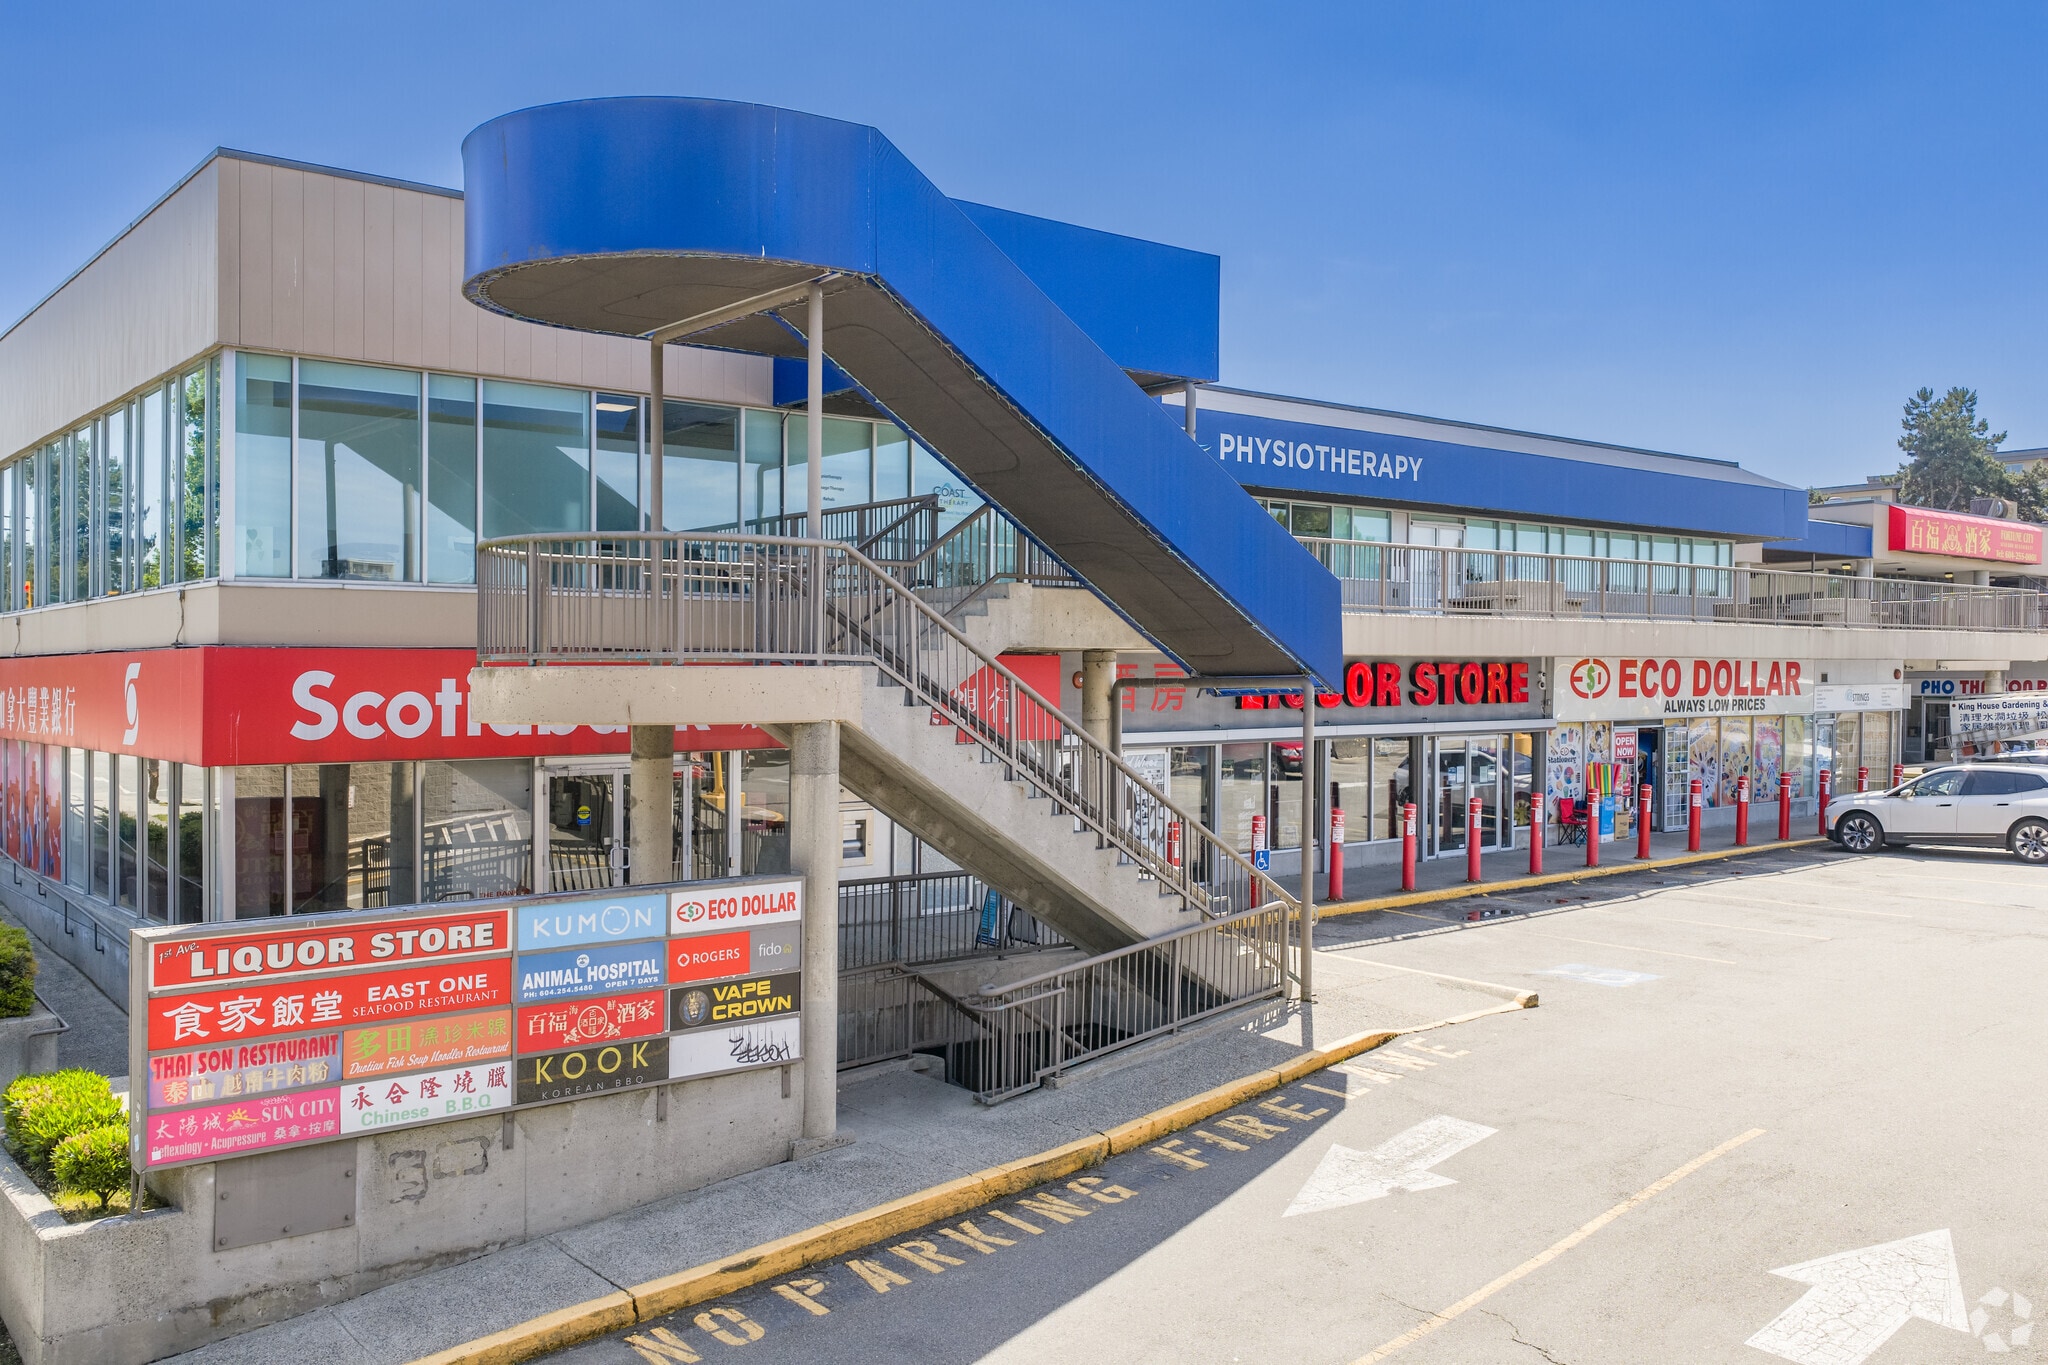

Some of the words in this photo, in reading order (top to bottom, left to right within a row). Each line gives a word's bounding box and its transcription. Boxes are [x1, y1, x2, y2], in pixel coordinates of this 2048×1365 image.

[1219, 432, 1423, 482] PHYSIOTHERAPY
[933, 485, 966, 498] COAST
[1409, 661, 1529, 708] STORE
[1618, 659, 1682, 698] ECO
[1692, 659, 1802, 697] DOLLAR
[1921, 680, 1955, 694] PHO
[1664, 699, 1706, 713] ALWAYS
[1708, 699, 1729, 713] LOW
[1731, 698, 1766, 712] PRICES
[1958, 702, 1975, 712] King
[1976, 702, 2000, 710] House
[2001, 700, 2040, 710] Gardening
[1615, 736, 1635, 746] OPEN
[1616, 747, 1634, 756] NOW
[708, 897, 738, 920] ECO
[741, 891, 797, 917] DOLLAR
[533, 905, 652, 938] KUMON
[158, 948, 173, 964] 1st
[175, 941, 200, 957] Ave.
[190, 937, 355, 978] LIQUOR
[370, 922, 494, 958] STORE
[692, 947, 740, 964] ROGERS
[758, 942, 782, 957] fido
[367, 980, 430, 1002] EAST
[439, 973, 488, 993] ONE
[522, 968, 583, 990] ANIMAL
[587, 958, 660, 983] HOSPITAL
[605, 980, 628, 989] OPEN
[638, 976, 659, 985] DAYS
[352, 1000, 414, 1017] SEAFOOD
[418, 989, 499, 1009] RESTAURANT
[539, 984, 593, 997] 604.254.5480
[712, 980, 771, 1002] VAPE
[162, 990, 343, 1041] 食家飯堂
[526, 1010, 568, 1036] 百福
[616, 999, 656, 1024] 酒家
[712, 994, 792, 1020] CROWN
[152, 1053, 194, 1080] THAI
[197, 1048, 234, 1076] SON
[237, 1034, 339, 1069] RESTAURANT
[349, 1061, 384, 1075] Duotian
[386, 1055, 405, 1069] Fish
[407, 1052, 429, 1067] Soup
[430, 1048, 464, 1063] Noodles
[464, 1041, 510, 1058] Restaurant
[535, 1041, 650, 1085] KOOK
[542, 1082, 605, 1100] KOREAN
[615, 1075, 644, 1087] BBQ
[262, 1103, 294, 1124] SUN
[299, 1097, 336, 1117] CITY
[361, 1106, 429, 1127] Chinese
[445, 1094, 491, 1114] B.B.Q
[154, 1112, 225, 1141] 太陽城
[211, 1131, 267, 1150] Acupressure
[624, 1307, 766, 1365] NO
[770, 1176, 1139, 1316] PARKING
[1150, 1095, 1329, 1171] FIRE
[1300, 1036, 1473, 1100] LANE
